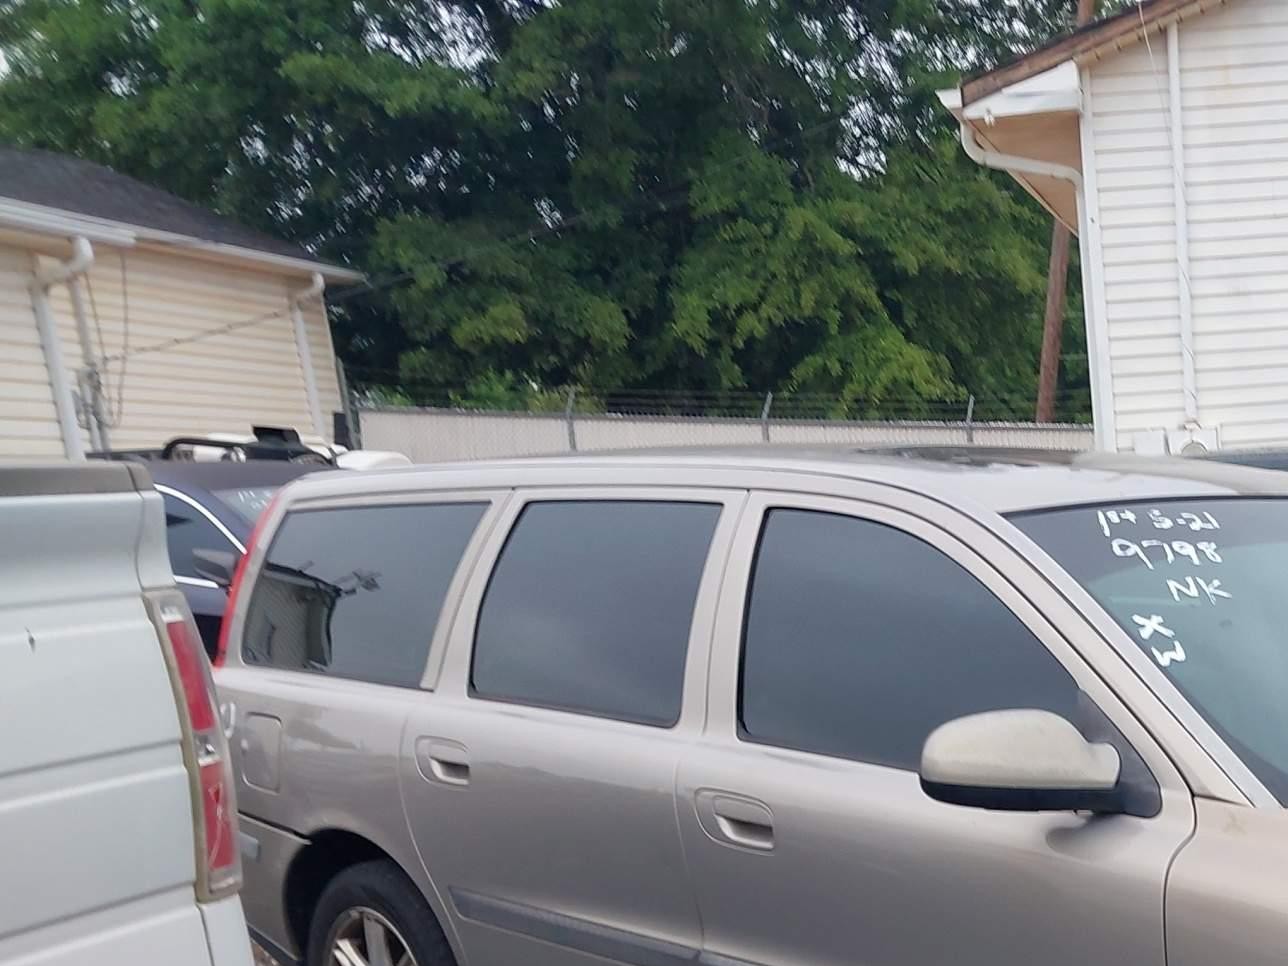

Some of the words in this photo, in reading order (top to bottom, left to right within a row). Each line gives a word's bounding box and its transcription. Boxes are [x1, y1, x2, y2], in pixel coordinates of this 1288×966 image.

[1147, 508, 1221, 531] 5-21
[1111, 538, 1223, 570] 9798
[1166, 576, 1233, 606] NK
